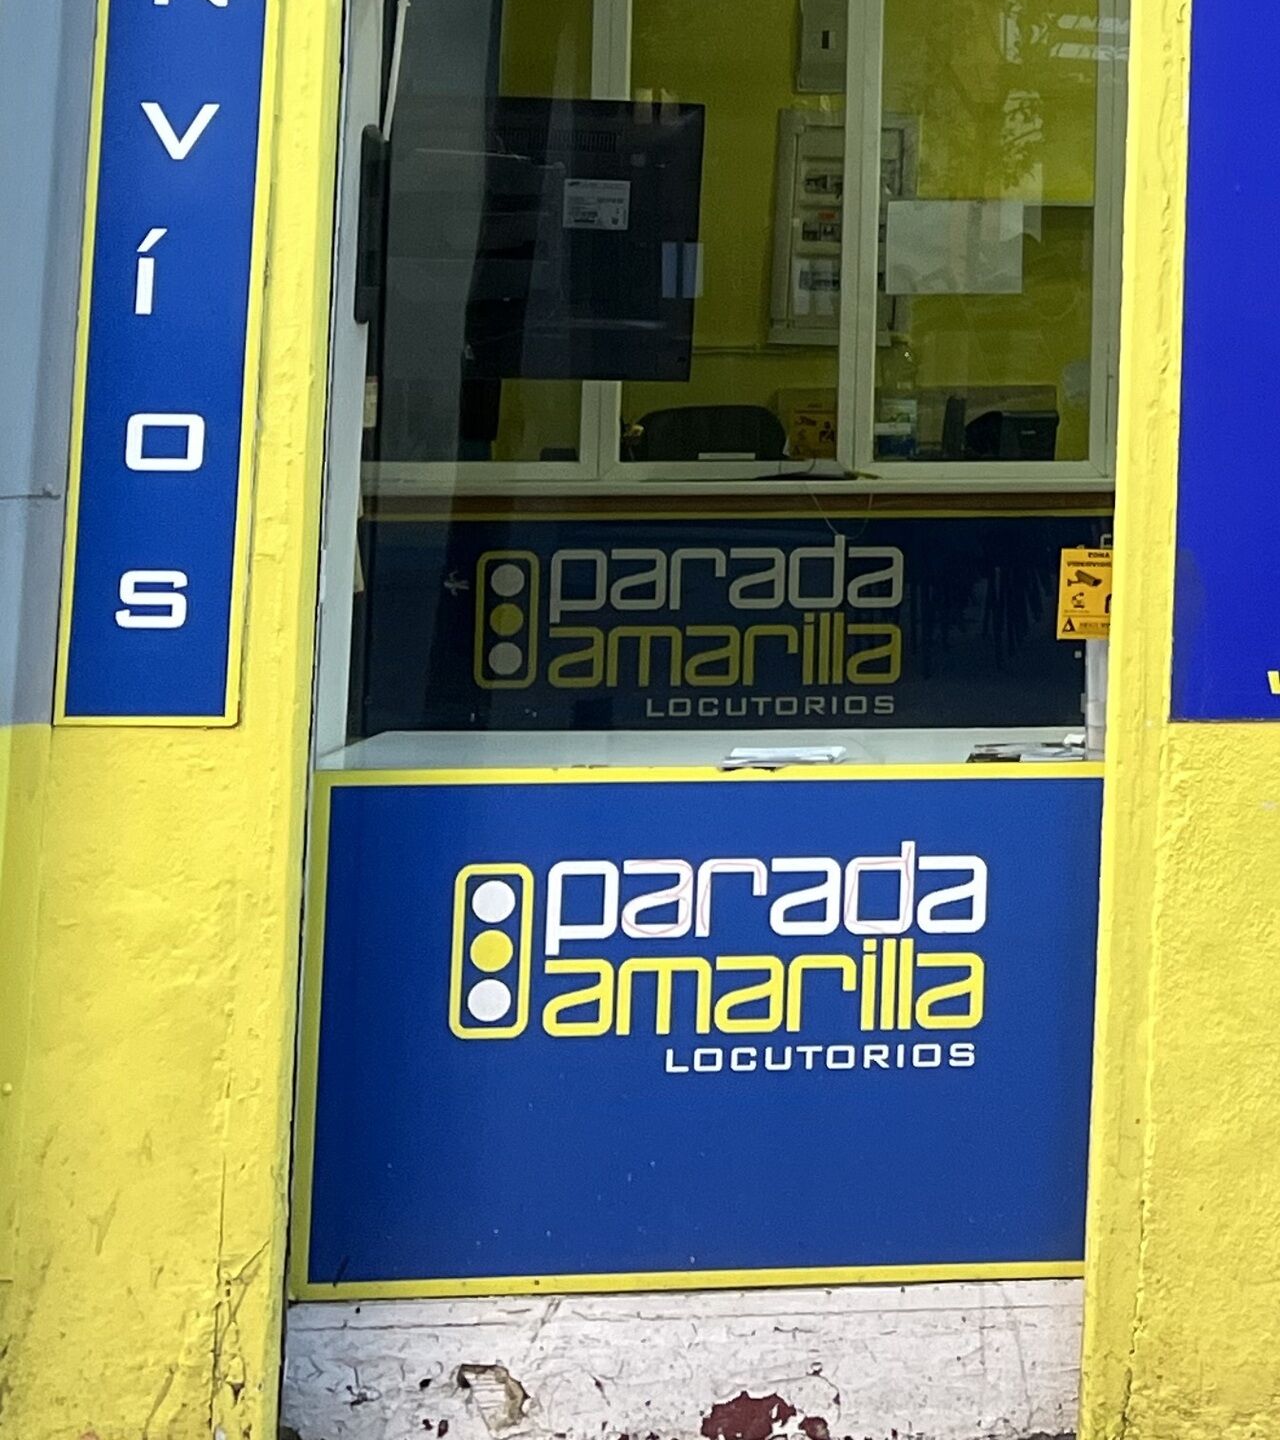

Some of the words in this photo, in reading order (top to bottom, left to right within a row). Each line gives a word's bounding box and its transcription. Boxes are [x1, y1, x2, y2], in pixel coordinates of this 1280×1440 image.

[549, 535, 903, 623] parada
[548, 612, 901, 687] amarilla
[646, 695, 894, 717] LOCUTORIOS
[544, 841, 988, 955] parada
[542, 938, 985, 1037] amarilla
[665, 1043, 975, 1073] LOCUTORIOS
